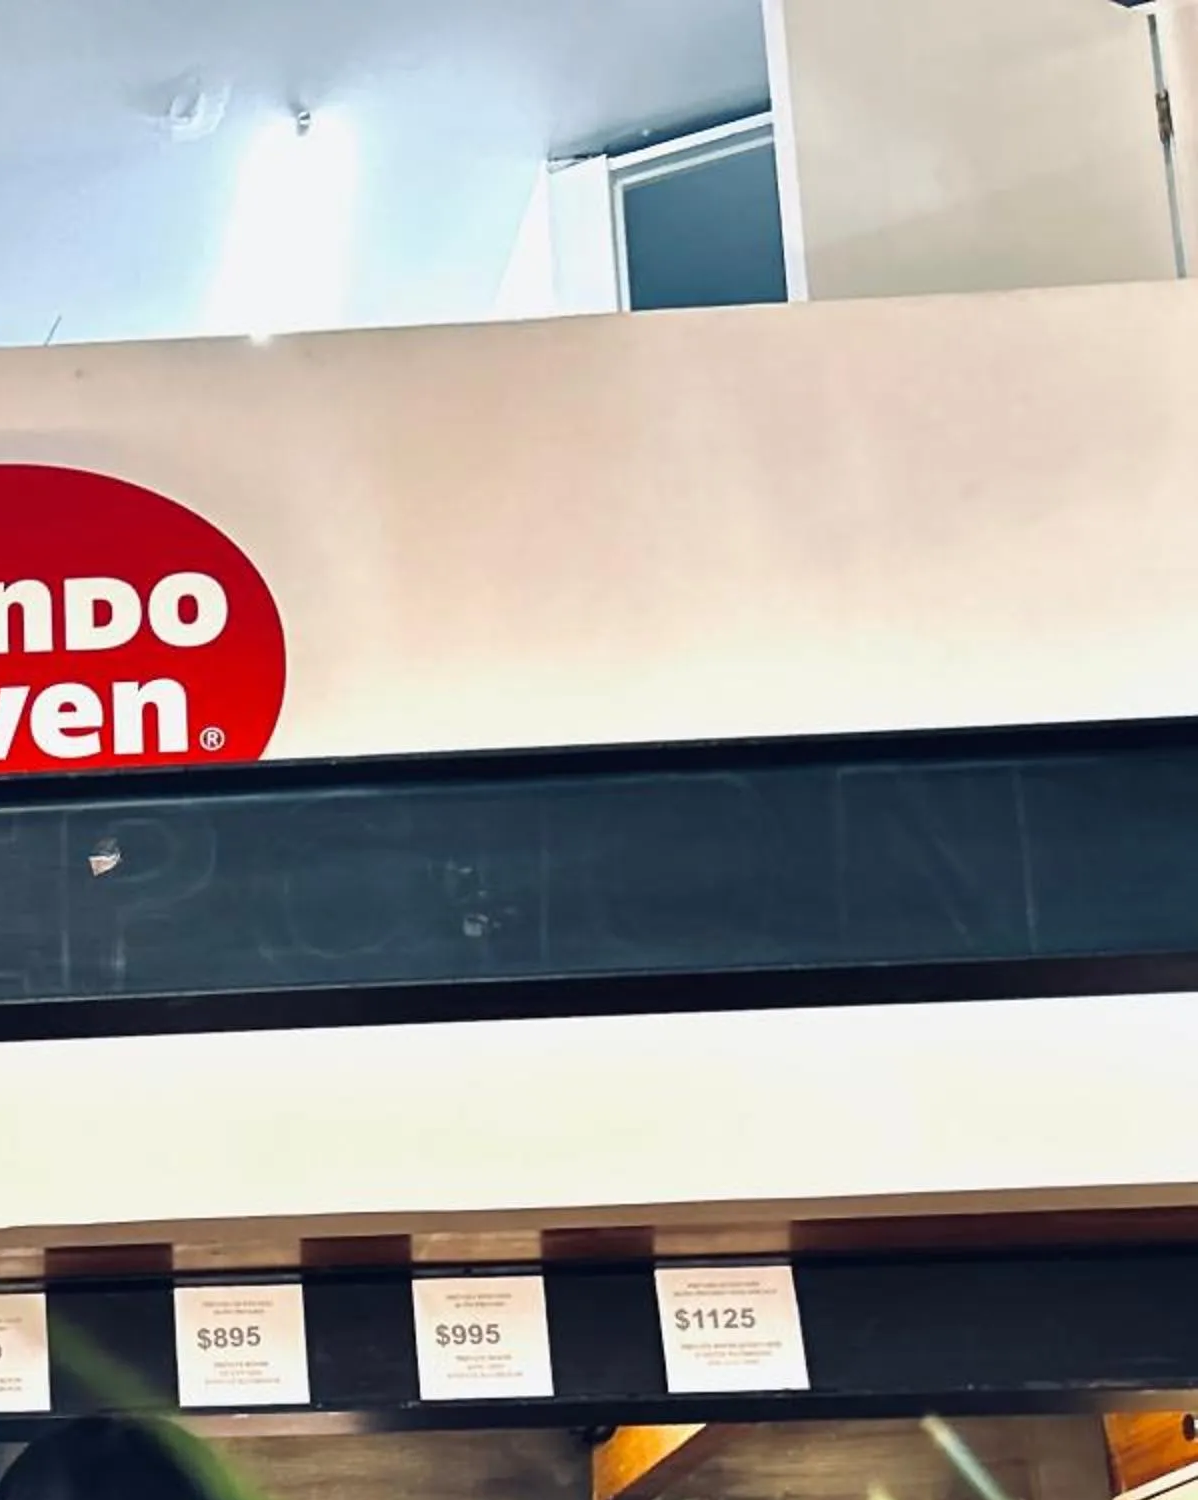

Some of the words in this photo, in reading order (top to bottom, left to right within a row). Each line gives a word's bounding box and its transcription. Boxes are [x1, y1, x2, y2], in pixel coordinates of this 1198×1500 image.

[674, 1307, 756, 1332] $1125
[196, 1326, 261, 1351] $895
[435, 1323, 501, 1348] $995
